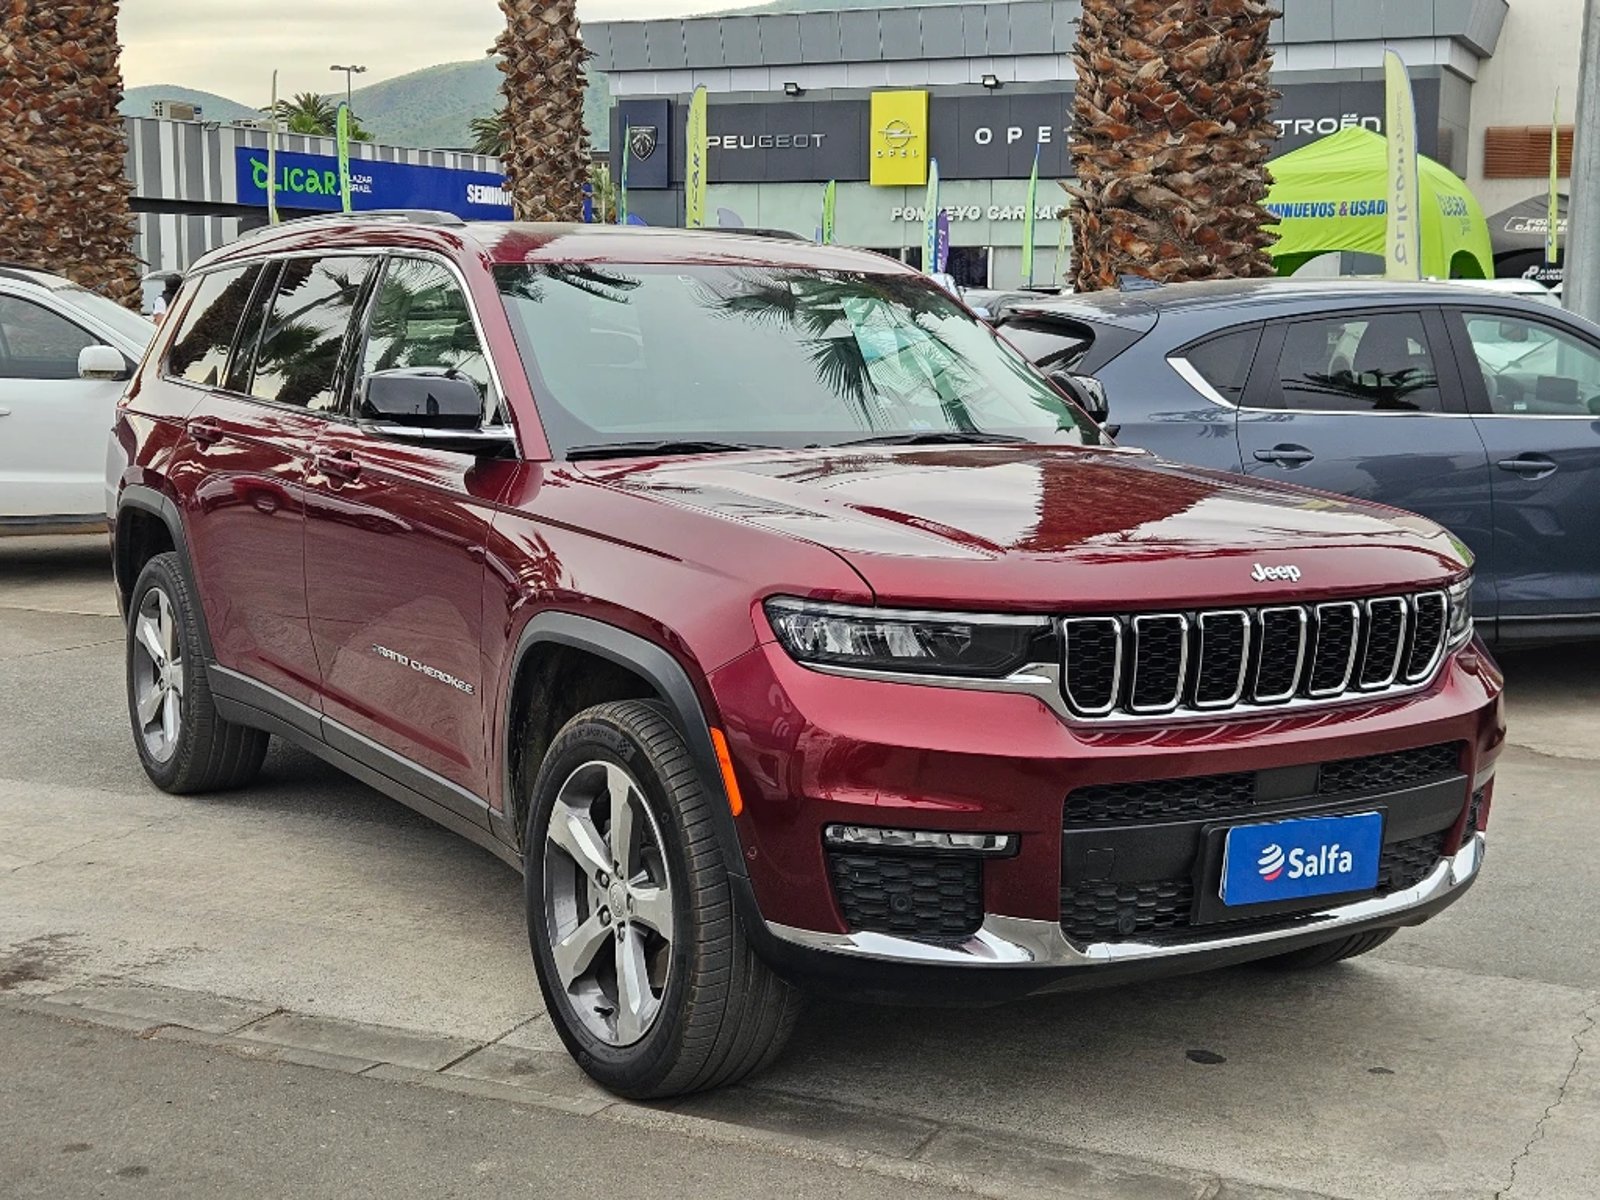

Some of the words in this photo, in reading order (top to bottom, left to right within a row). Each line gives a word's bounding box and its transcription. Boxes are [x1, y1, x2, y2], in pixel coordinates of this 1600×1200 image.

[1273, 113, 1381, 136] TROËN
[706, 133, 826, 149] PEUGEOT
[974, 125, 1075, 145] OPE
[876, 149, 920, 158] OPEL
[891, 204, 981, 221] POMEYO
[1338, 201, 1348, 217] &
[1350, 199, 1388, 217] USAD
[1251, 562, 1301, 582] Jeep
[410, 660, 475, 695] CHEROKEE
[1287, 843, 1353, 879] Salfa
